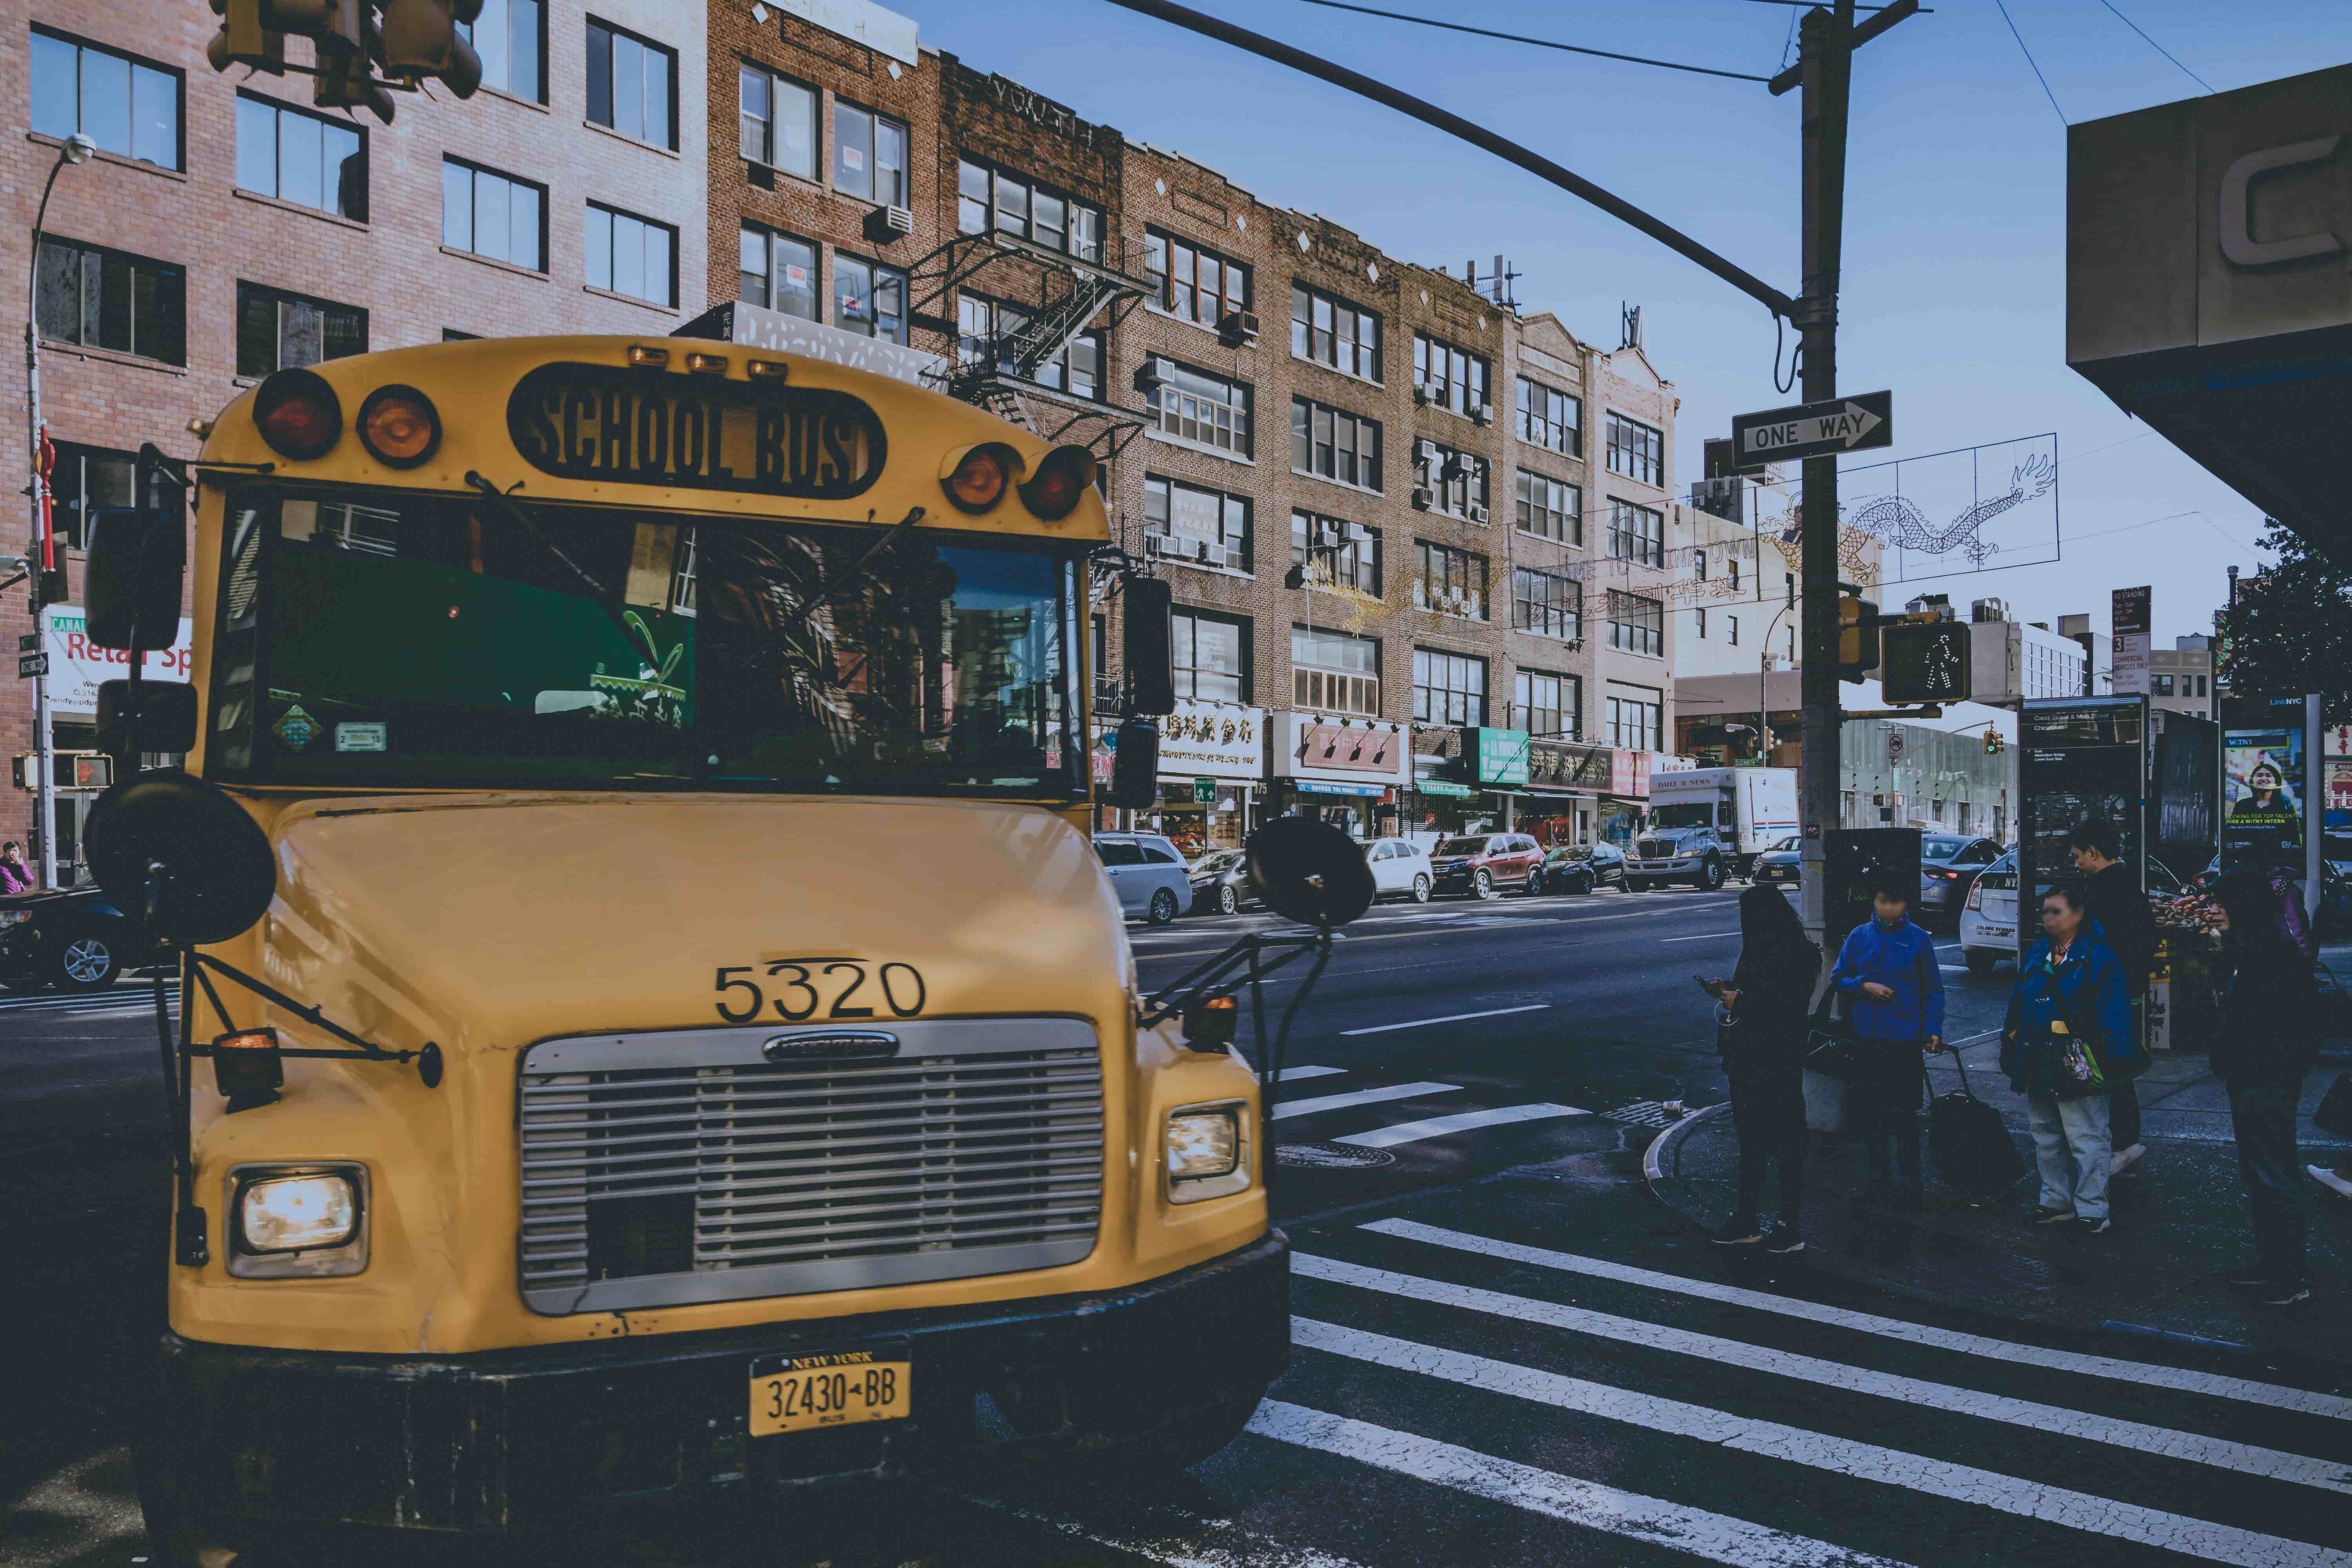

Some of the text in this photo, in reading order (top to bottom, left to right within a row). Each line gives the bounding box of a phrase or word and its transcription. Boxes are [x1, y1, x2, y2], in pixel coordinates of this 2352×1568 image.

[532, 389, 856, 485] SCHOOL BUS
[1756, 413, 1866, 448] ONE WAY
[1606, 557, 1629, 576] TO
[1641, 539, 1756, 572] CHINATOWN
[2122, 590, 2145, 598] STANDING
[2115, 637, 2122, 652] 3
[2005, 878, 2018, 887] NY
[715, 962, 926, 1023] 5320
[792, 1351, 873, 1370] NEW YORK
